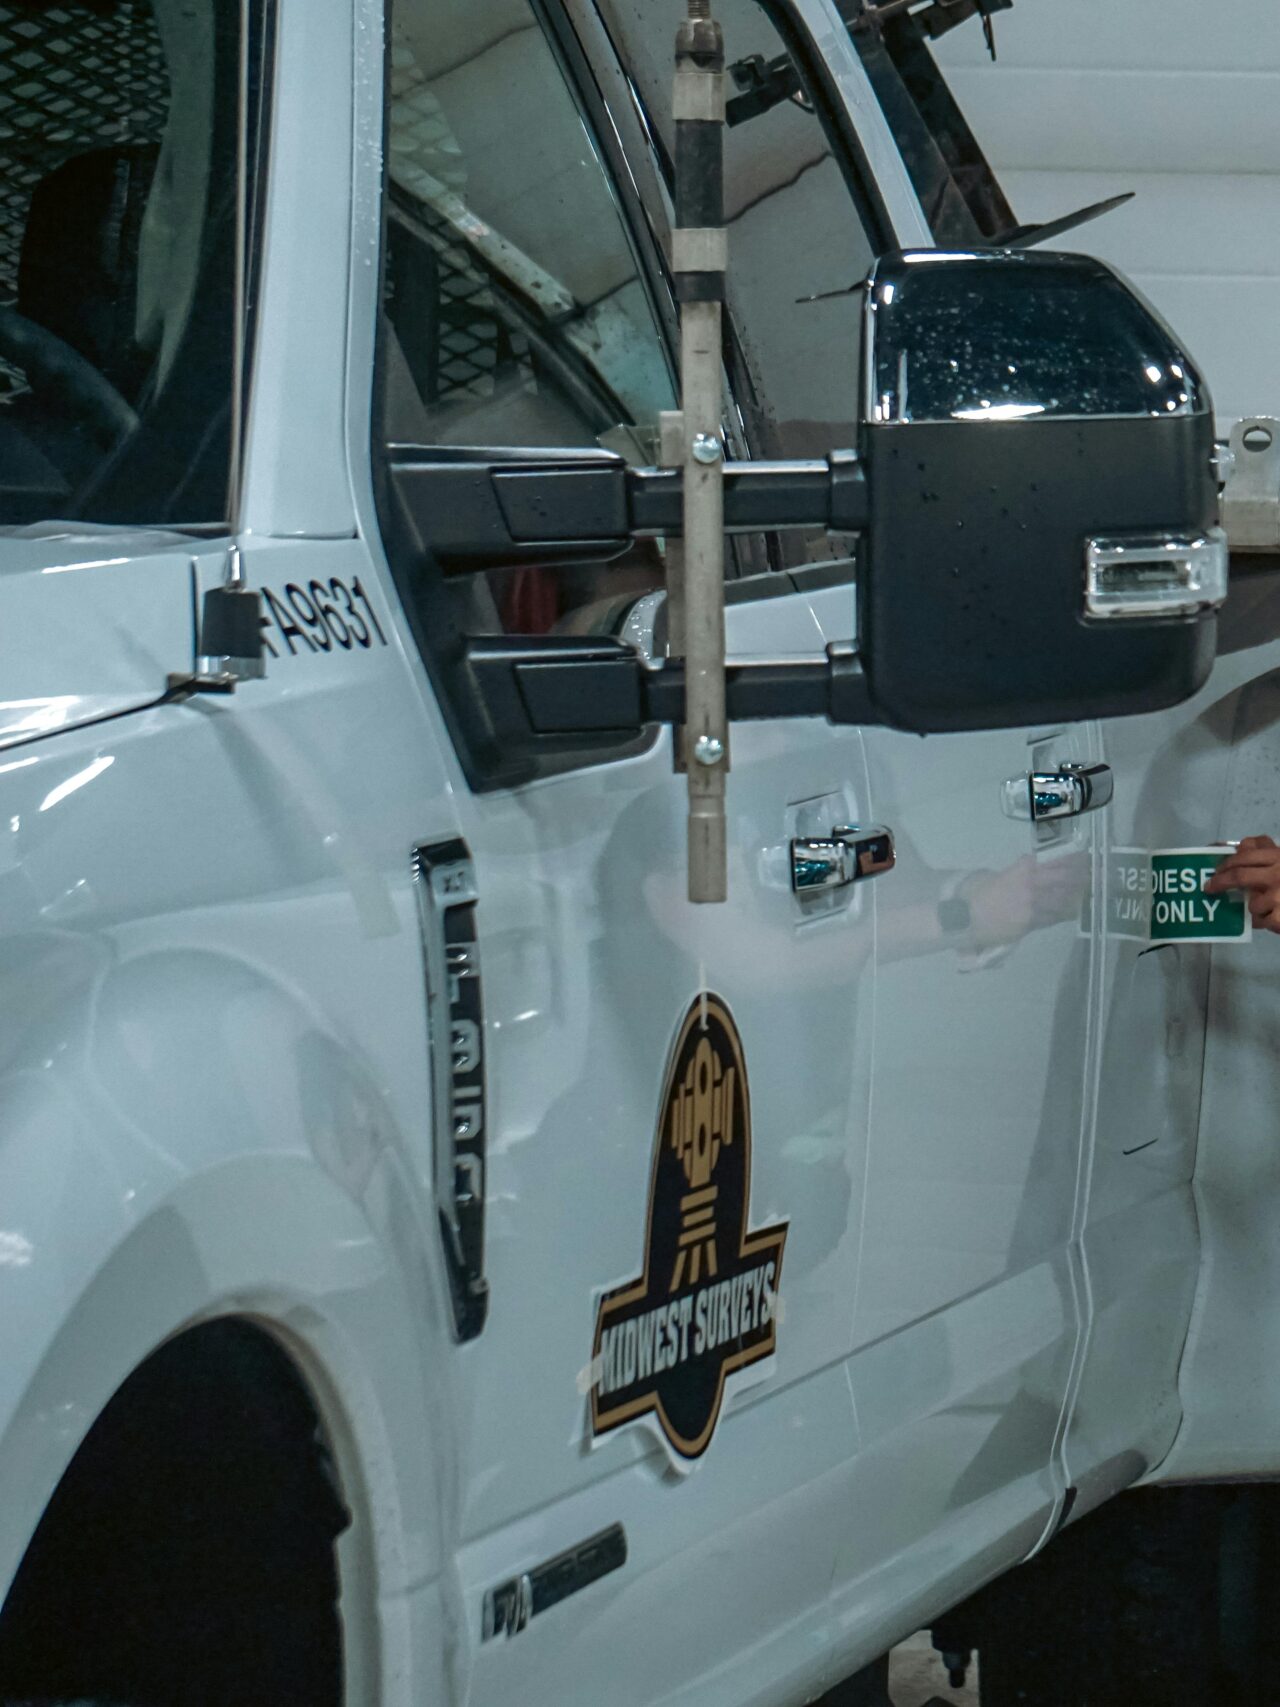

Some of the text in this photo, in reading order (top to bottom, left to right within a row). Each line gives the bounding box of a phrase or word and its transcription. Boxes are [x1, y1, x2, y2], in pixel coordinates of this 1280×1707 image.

[1156, 899, 1221, 924] ONLY
[598, 1261, 775, 1398] MIDWEST SURVEYS
